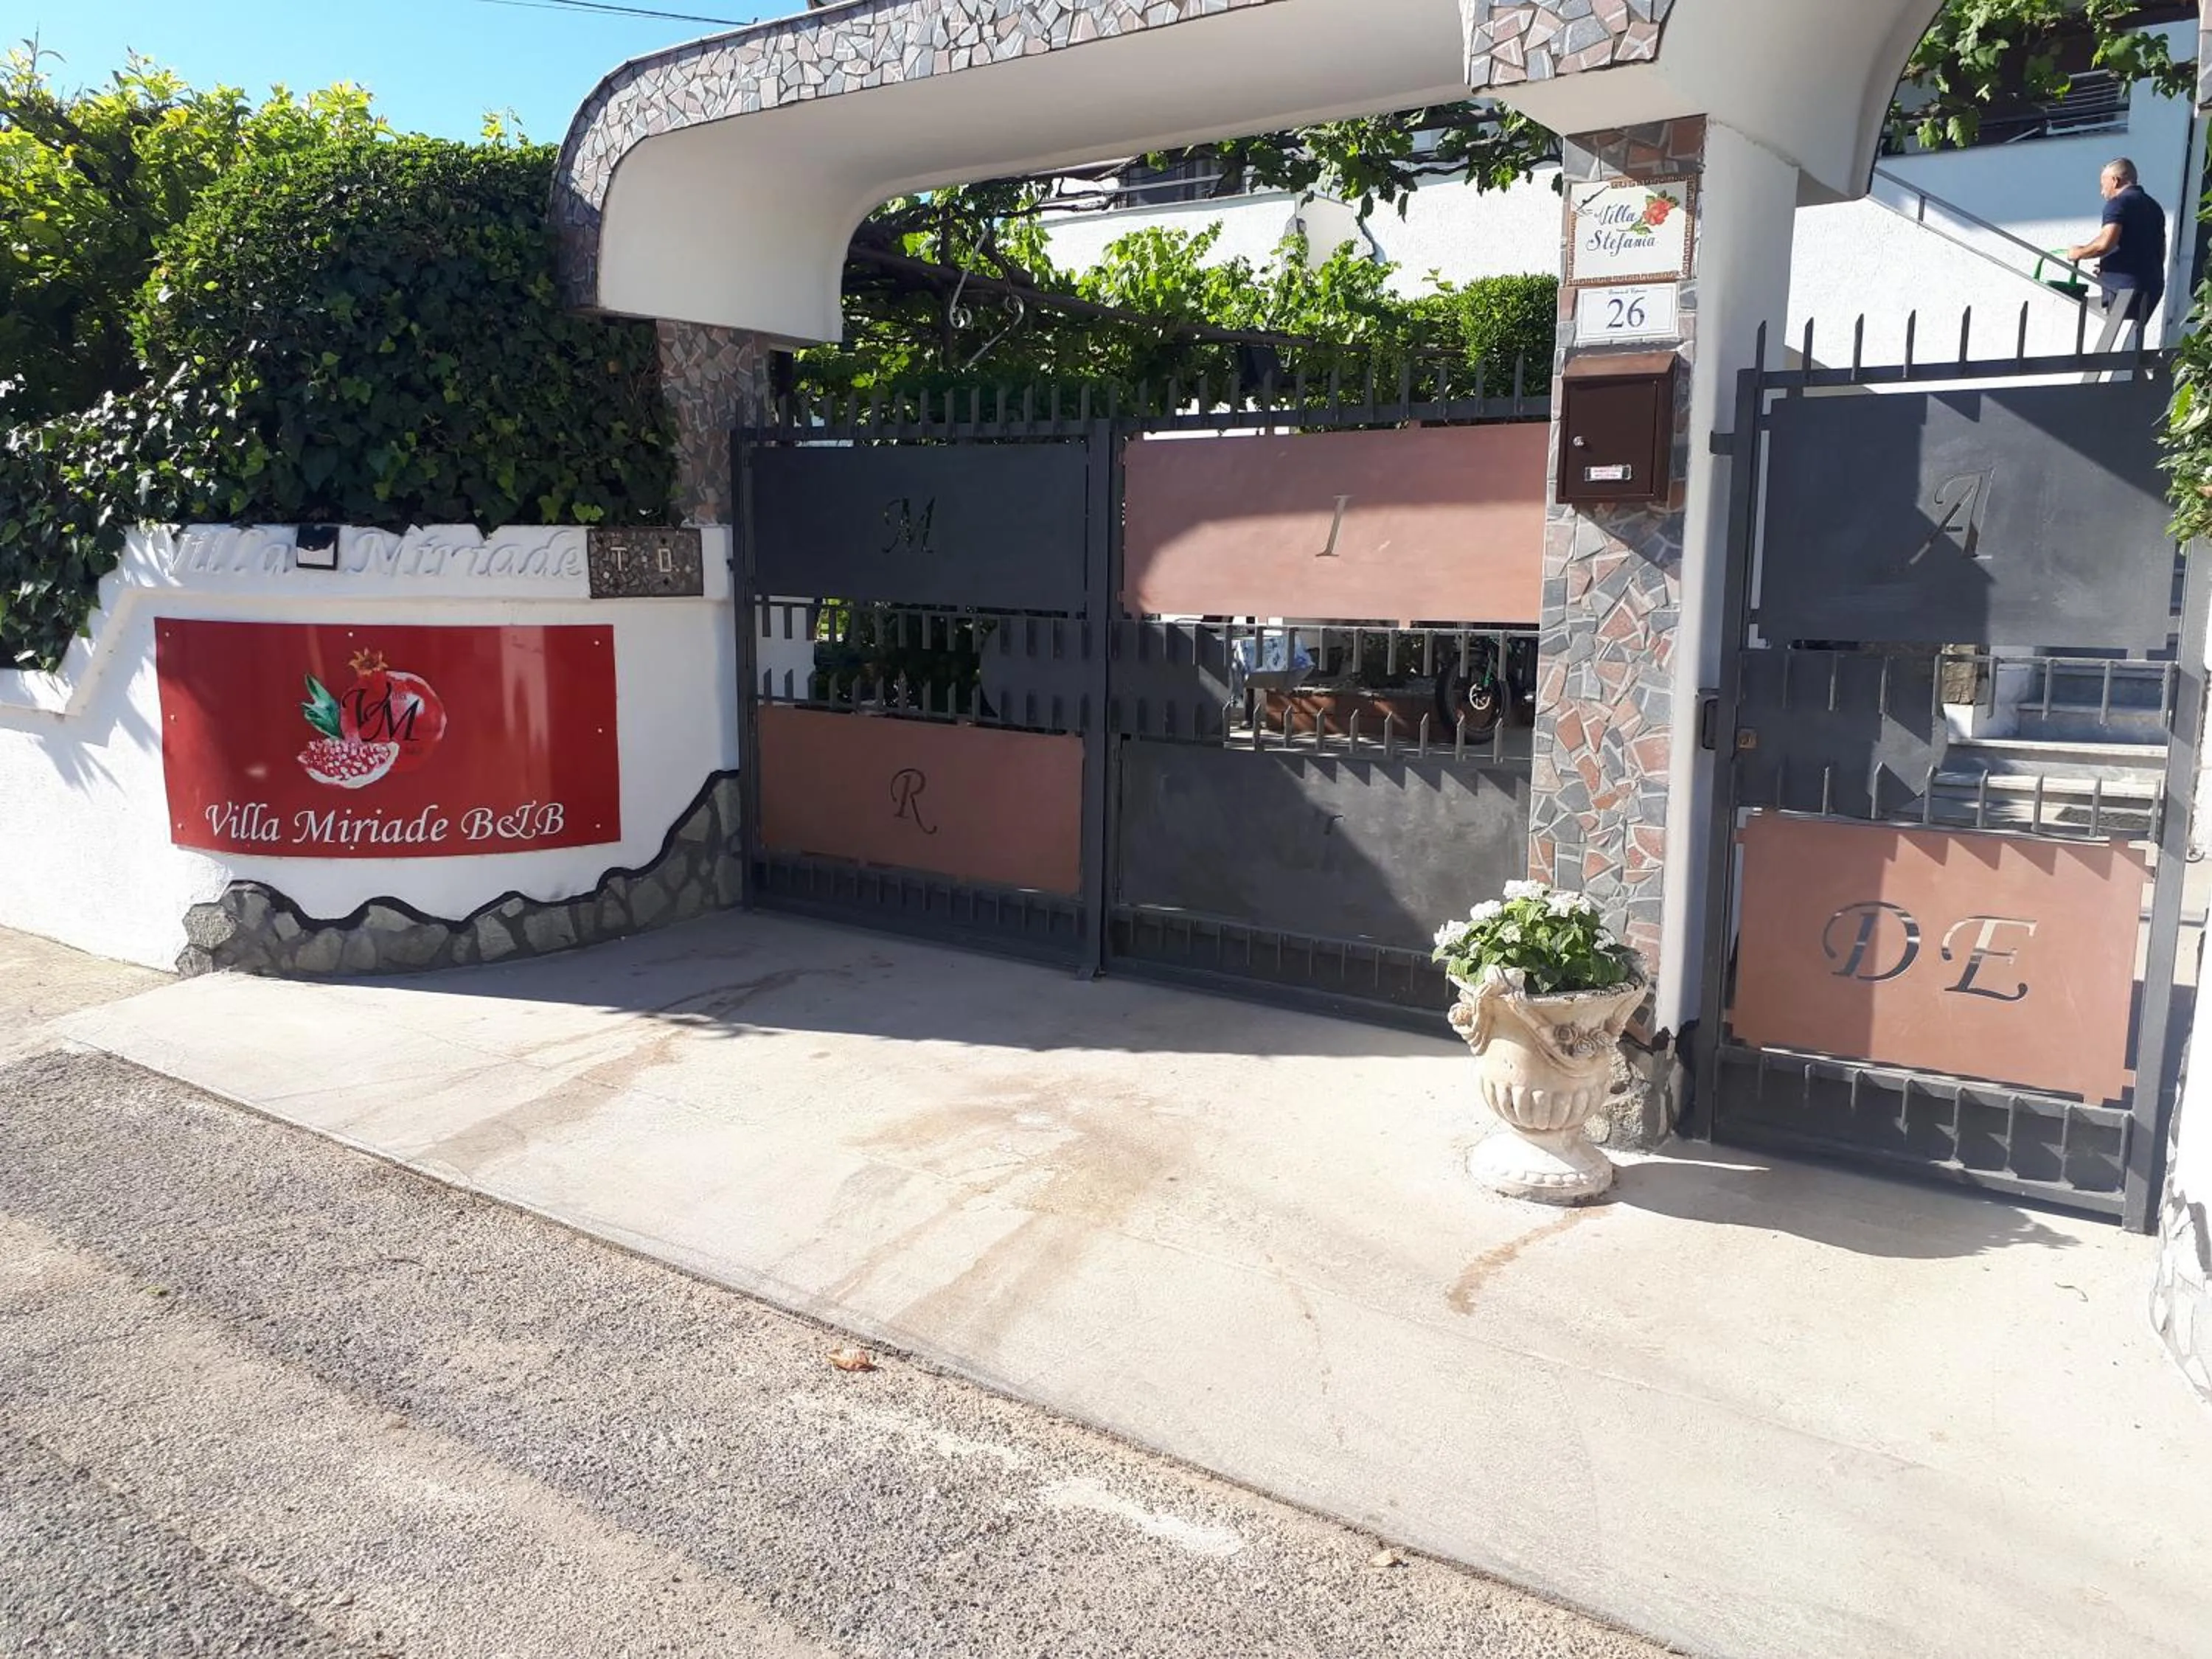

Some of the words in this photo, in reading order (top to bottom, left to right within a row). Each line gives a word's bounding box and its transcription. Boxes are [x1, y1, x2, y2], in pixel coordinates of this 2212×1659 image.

[1594, 204, 1636, 225] Villa
[1586, 229, 1655, 257] Stefania
[1606, 296, 1646, 329] 26
[890, 768, 937, 834] R
[206, 801, 281, 842] Villa
[292, 804, 449, 844] Miriade
[460, 799, 565, 841] B&B
